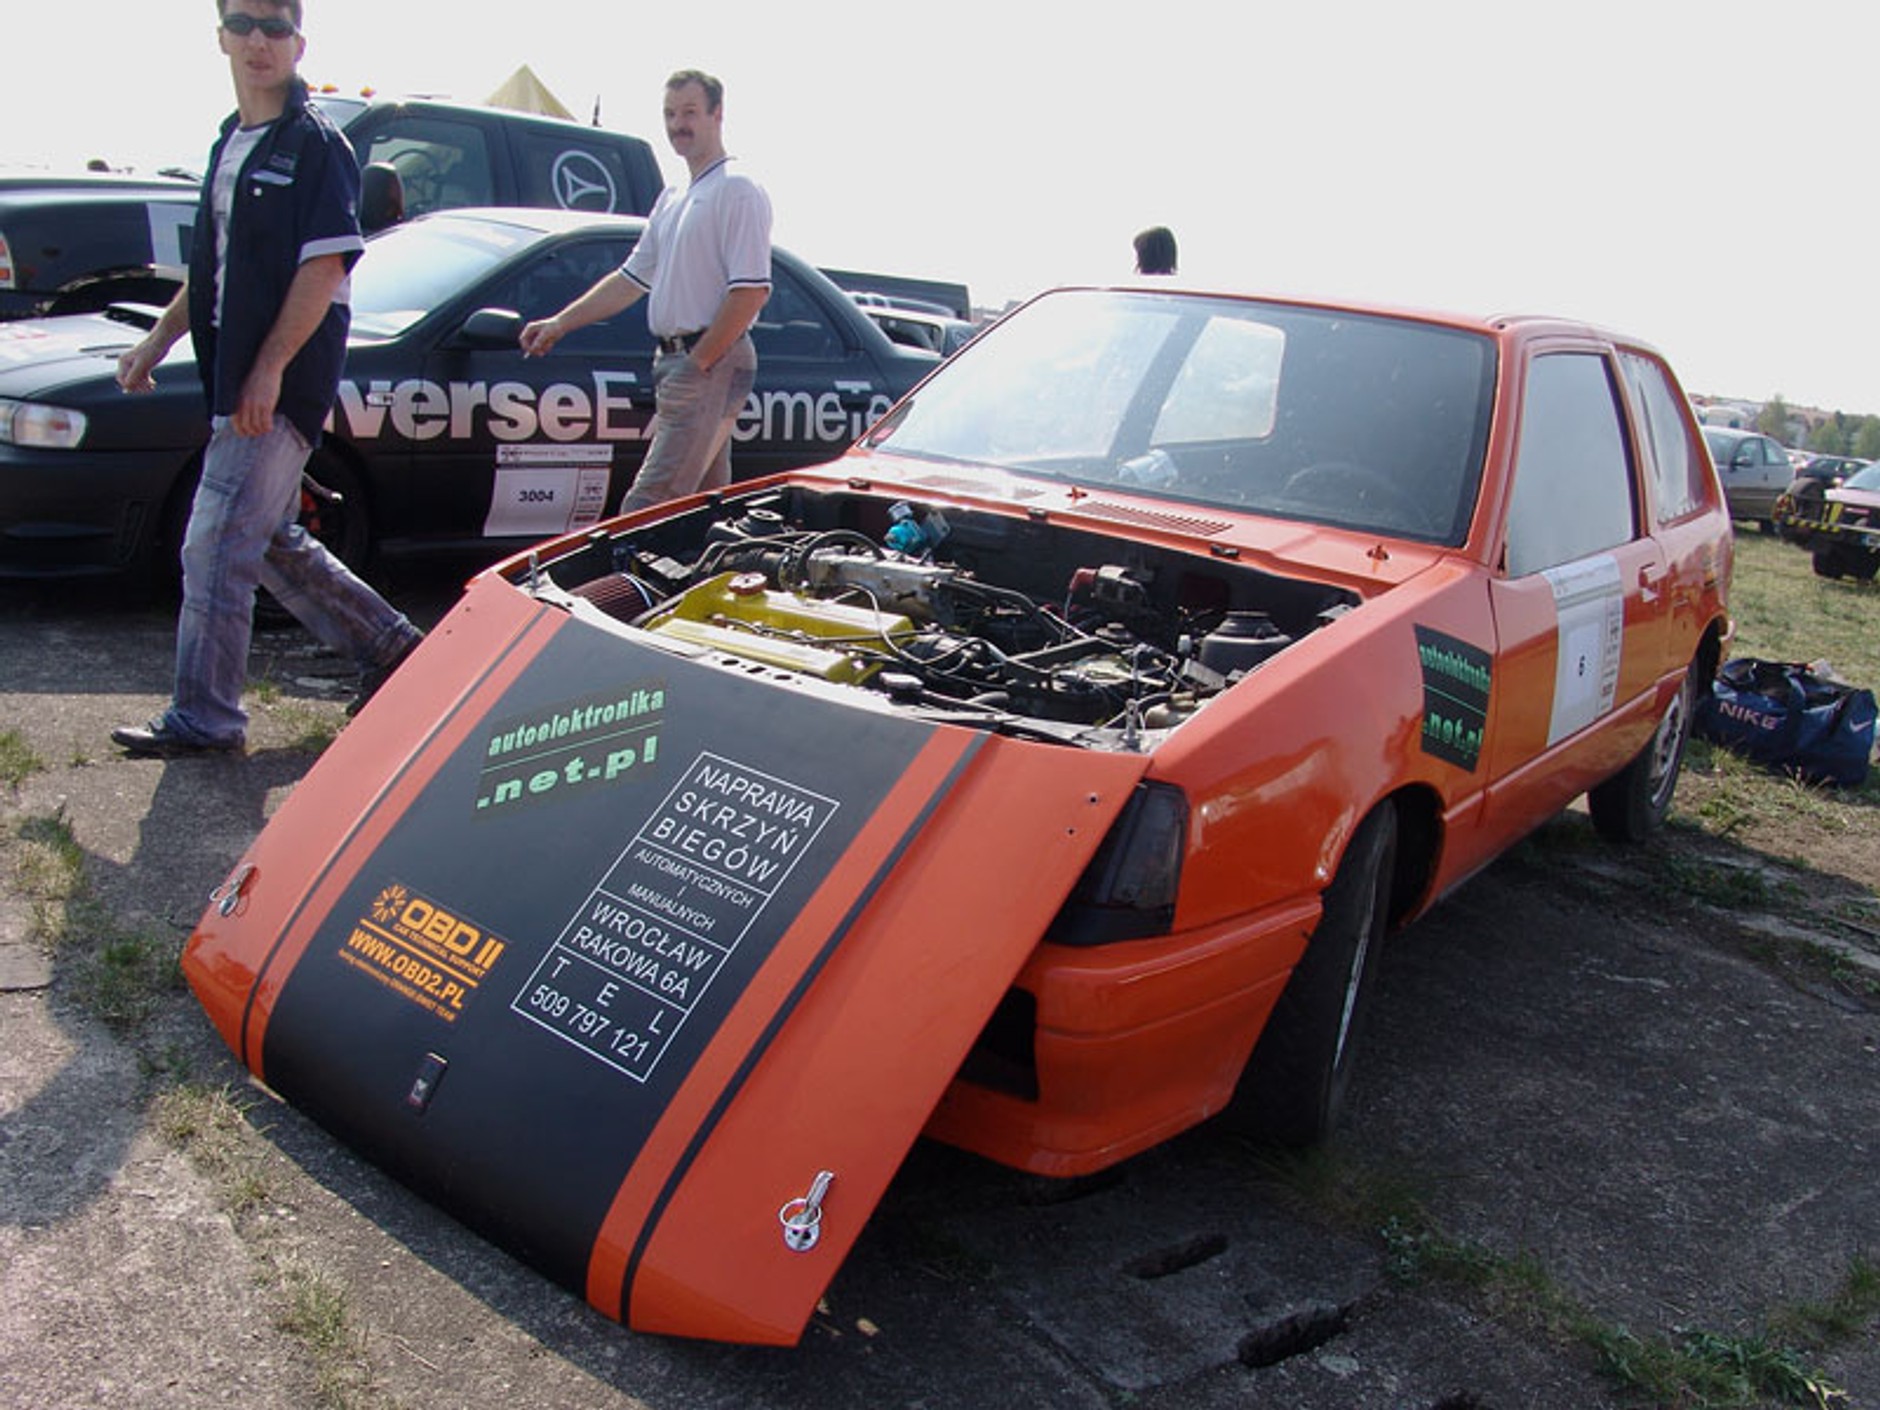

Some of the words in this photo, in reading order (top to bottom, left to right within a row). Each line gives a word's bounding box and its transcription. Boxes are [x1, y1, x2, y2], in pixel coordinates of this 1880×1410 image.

[518, 489, 554, 503] 3004
[488, 689, 665, 757] autoelektronika
[1719, 701, 1779, 730] NIKE
[476, 735, 659, 809] .net.pl
[695, 765, 816, 828] NAPRAWA
[652, 817, 779, 883] BIEGÓW
[674, 791, 799, 855] SKRZYŃ
[627, 883, 716, 932] MANUALNYCH
[634, 848, 755, 909] AUTOMATYCZNYCH
[400, 898, 482, 956] OBD
[591, 901, 714, 972] WROCŁAW
[348, 928, 467, 1009] WWW.OBD2.PL
[571, 926, 660, 985] RAKOWA
[660, 970, 690, 1000] 6A
[529, 983, 570, 1018] 509
[568, 1004, 611, 1038] 797
[609, 1028, 651, 1062] 121
